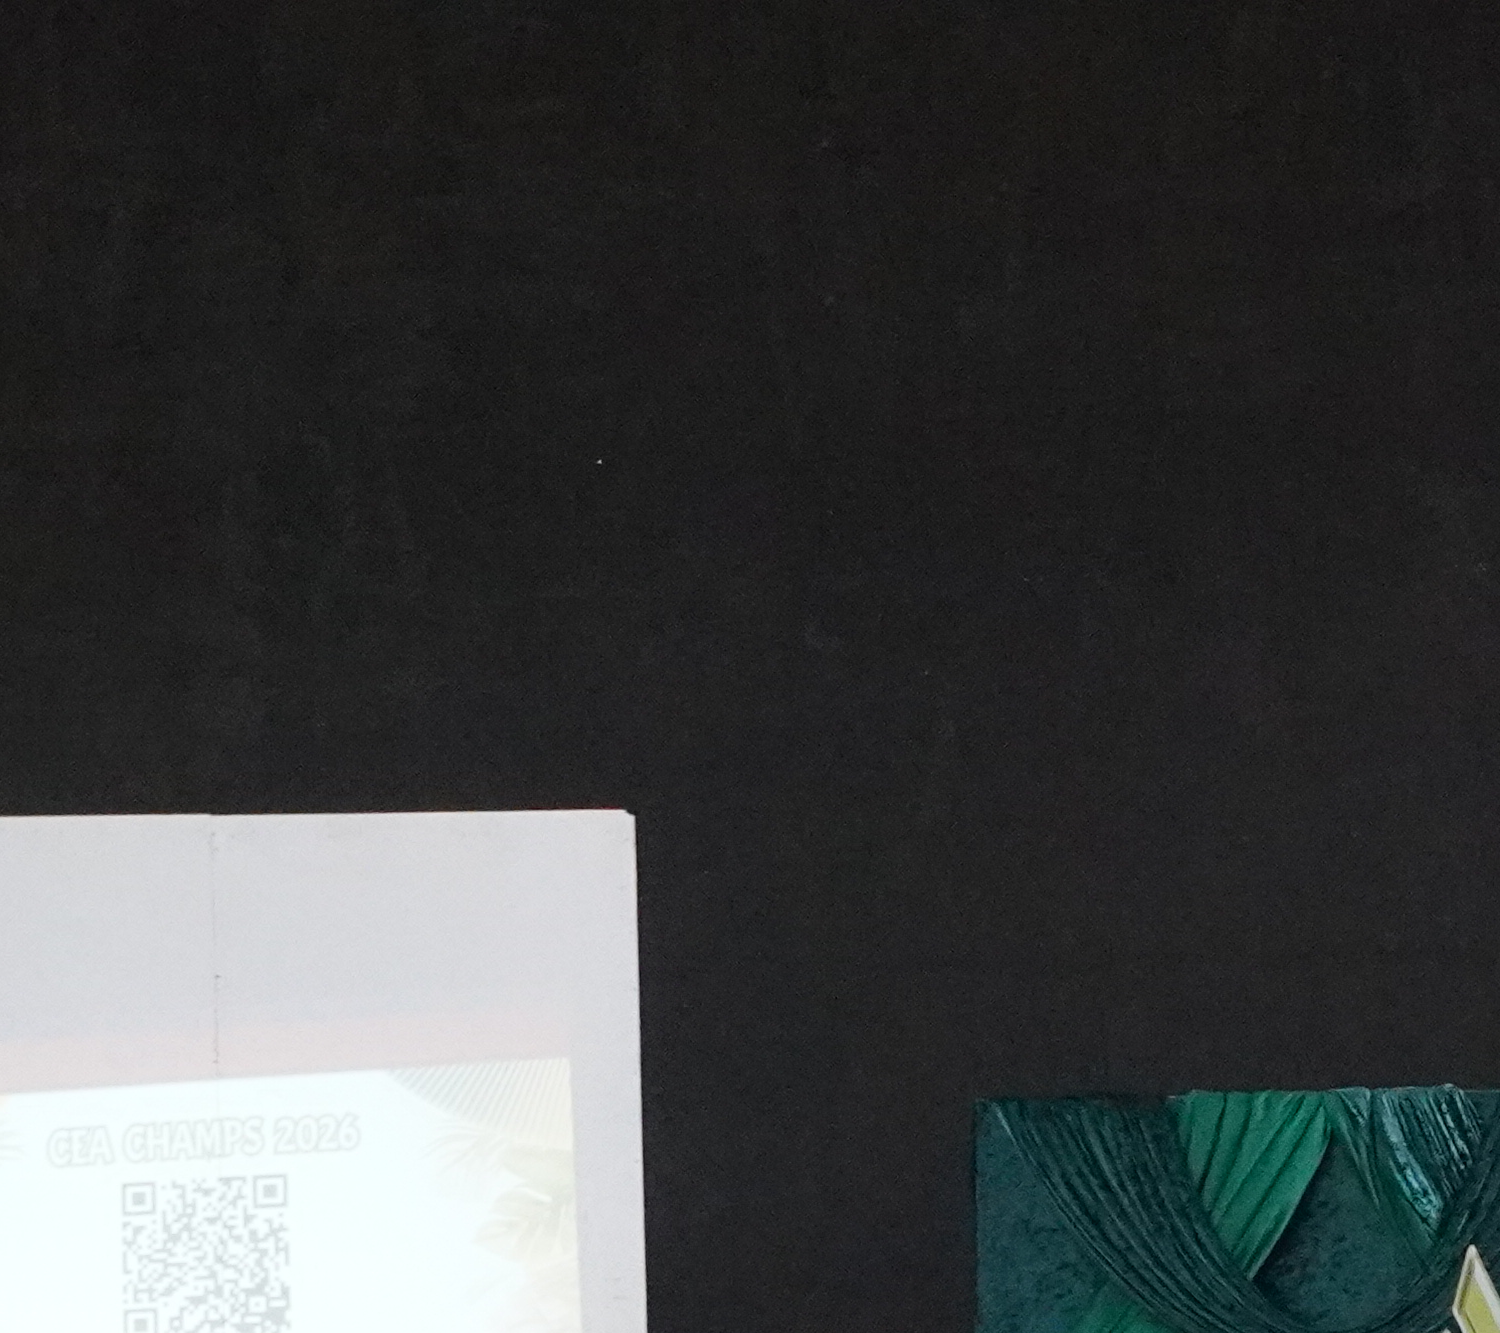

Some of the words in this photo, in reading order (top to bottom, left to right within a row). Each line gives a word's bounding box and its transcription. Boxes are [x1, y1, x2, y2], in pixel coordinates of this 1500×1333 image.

[47, 1126, 115, 1167] CEA
[122, 1116, 265, 1163] CHAMPS
[273, 1112, 362, 1155] 2026
